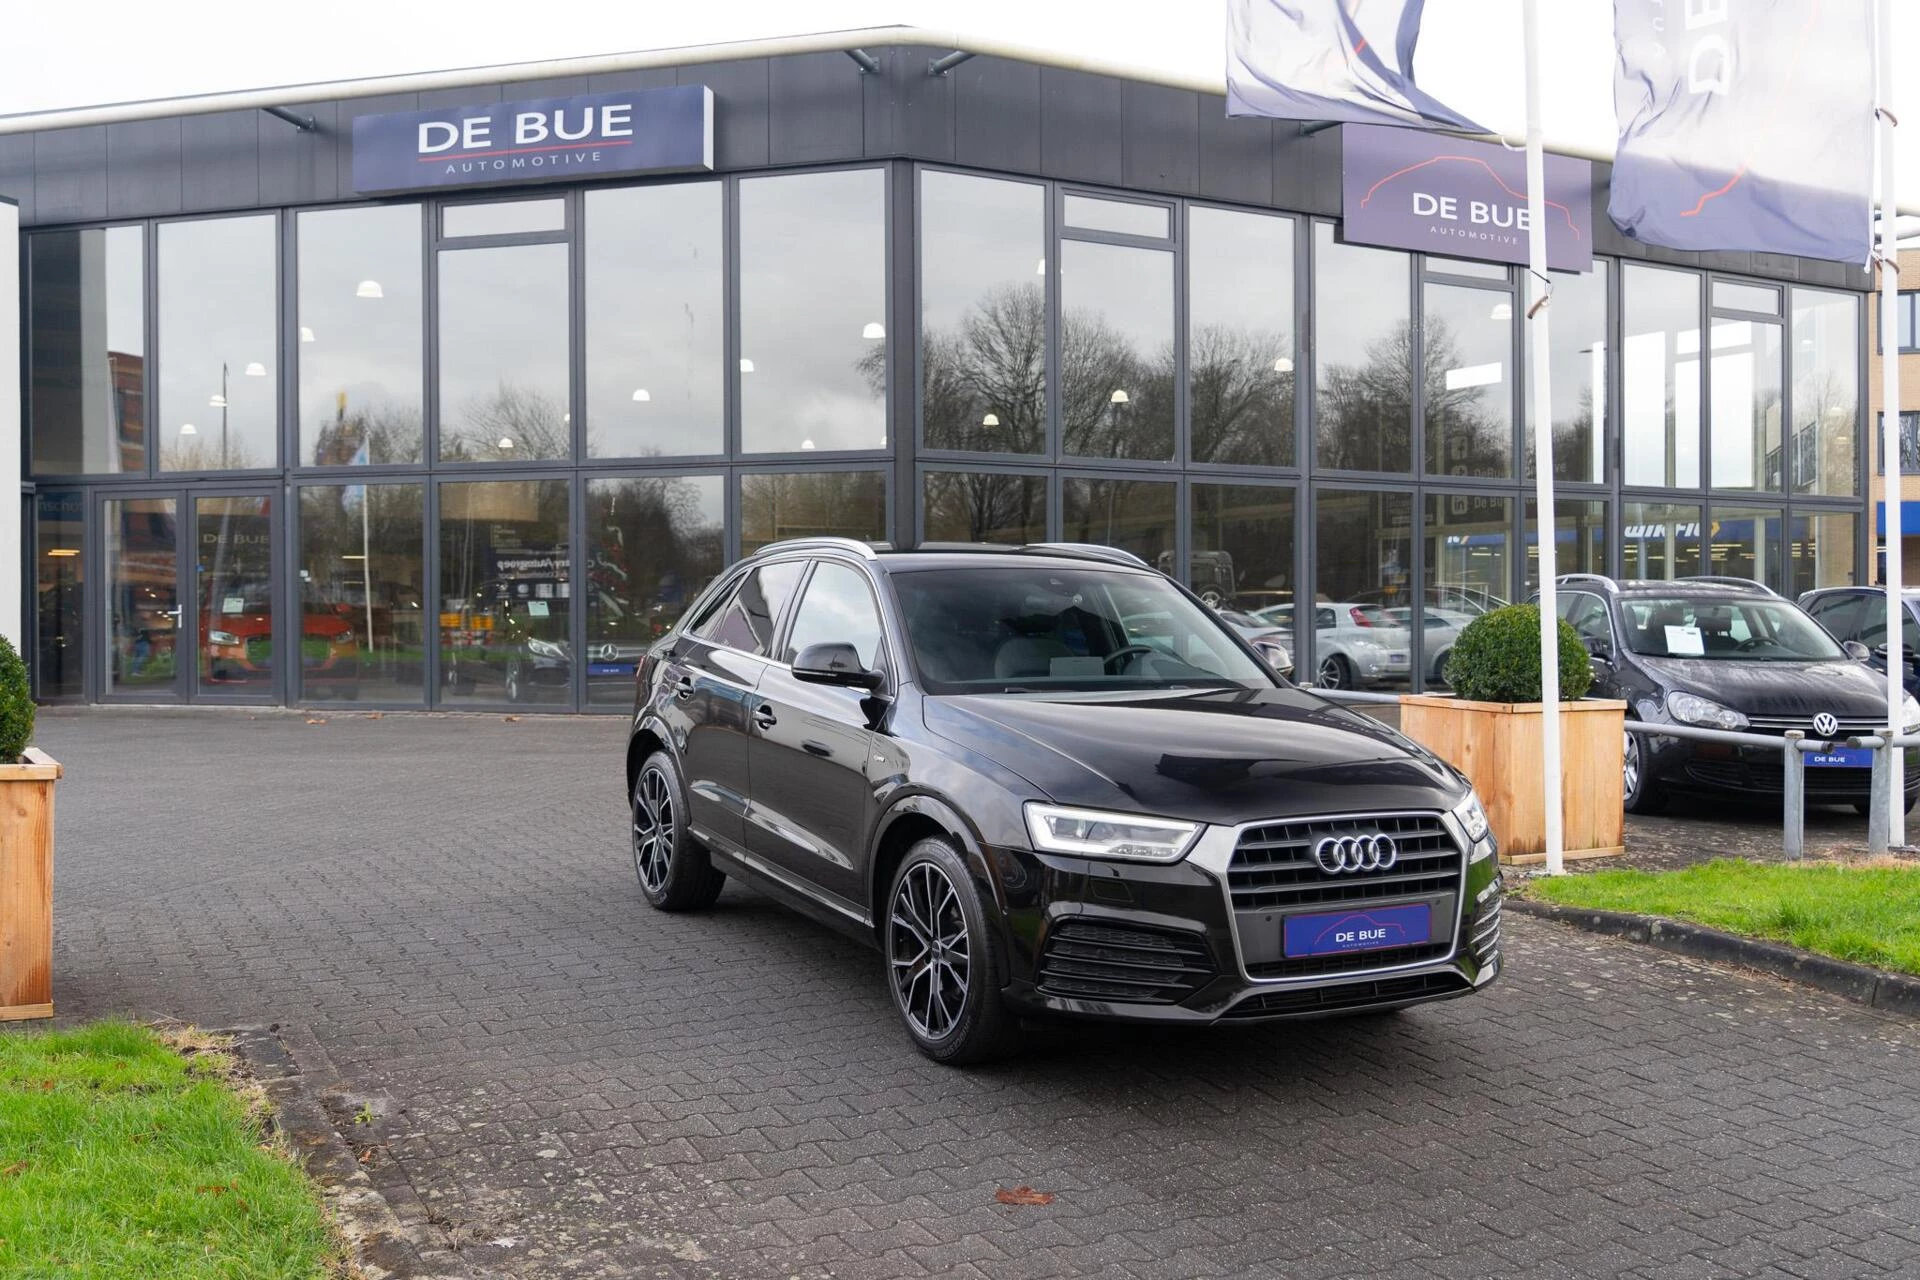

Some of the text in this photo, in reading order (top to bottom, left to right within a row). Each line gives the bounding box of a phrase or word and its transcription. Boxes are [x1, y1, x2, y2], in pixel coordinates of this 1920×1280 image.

[418, 104, 633, 154] DE BUE
[445, 151, 601, 174] AUTOMOTIVE
[1413, 192, 1531, 231] DE BUE
[1430, 226, 1519, 245] AUTOMOTIVE
[203, 533, 228, 545] DE
[1335, 928, 1386, 942] DE BUE
